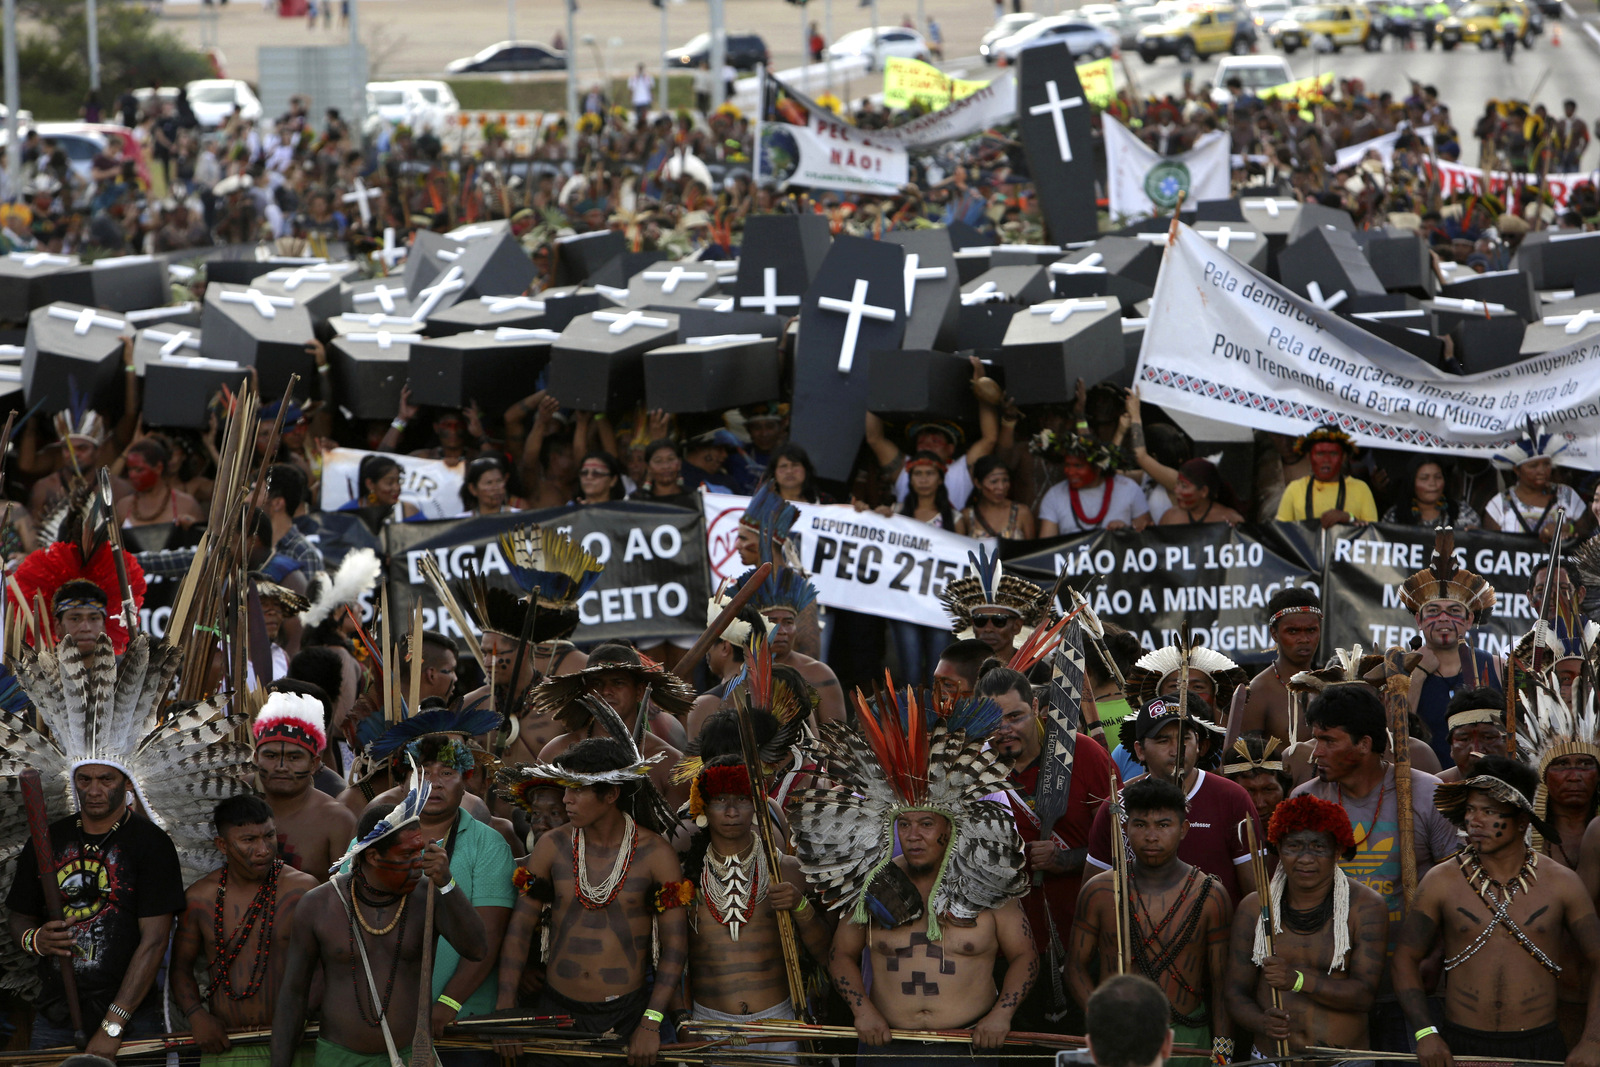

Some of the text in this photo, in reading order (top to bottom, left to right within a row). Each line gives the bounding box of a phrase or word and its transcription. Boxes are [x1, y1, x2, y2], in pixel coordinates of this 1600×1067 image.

[830, 149, 882, 171] NÃO!
[1204, 261, 1238, 292] Pela
[1212, 333, 1251, 365] Povo
[1340, 383, 1360, 405] da
[1366, 390, 1411, 416] Barra
[1416, 399, 1438, 418] do
[1268, 326, 1305, 356] Pela
[1417, 380, 1496, 410] imediata
[1500, 390, 1519, 410] da
[1523, 386, 1557, 405] terra
[1560, 378, 1578, 397] do
[812, 516, 933, 553] DEPUTADOS DIGAM:
[407, 542, 510, 584] DIGA
[623, 524, 683, 563] AO
[812, 536, 971, 600] PEC 215
[1054, 542, 1264, 576] NÃO AO PL 1610
[1334, 537, 1424, 570] RETIRE
[1138, 588, 1157, 613] A
